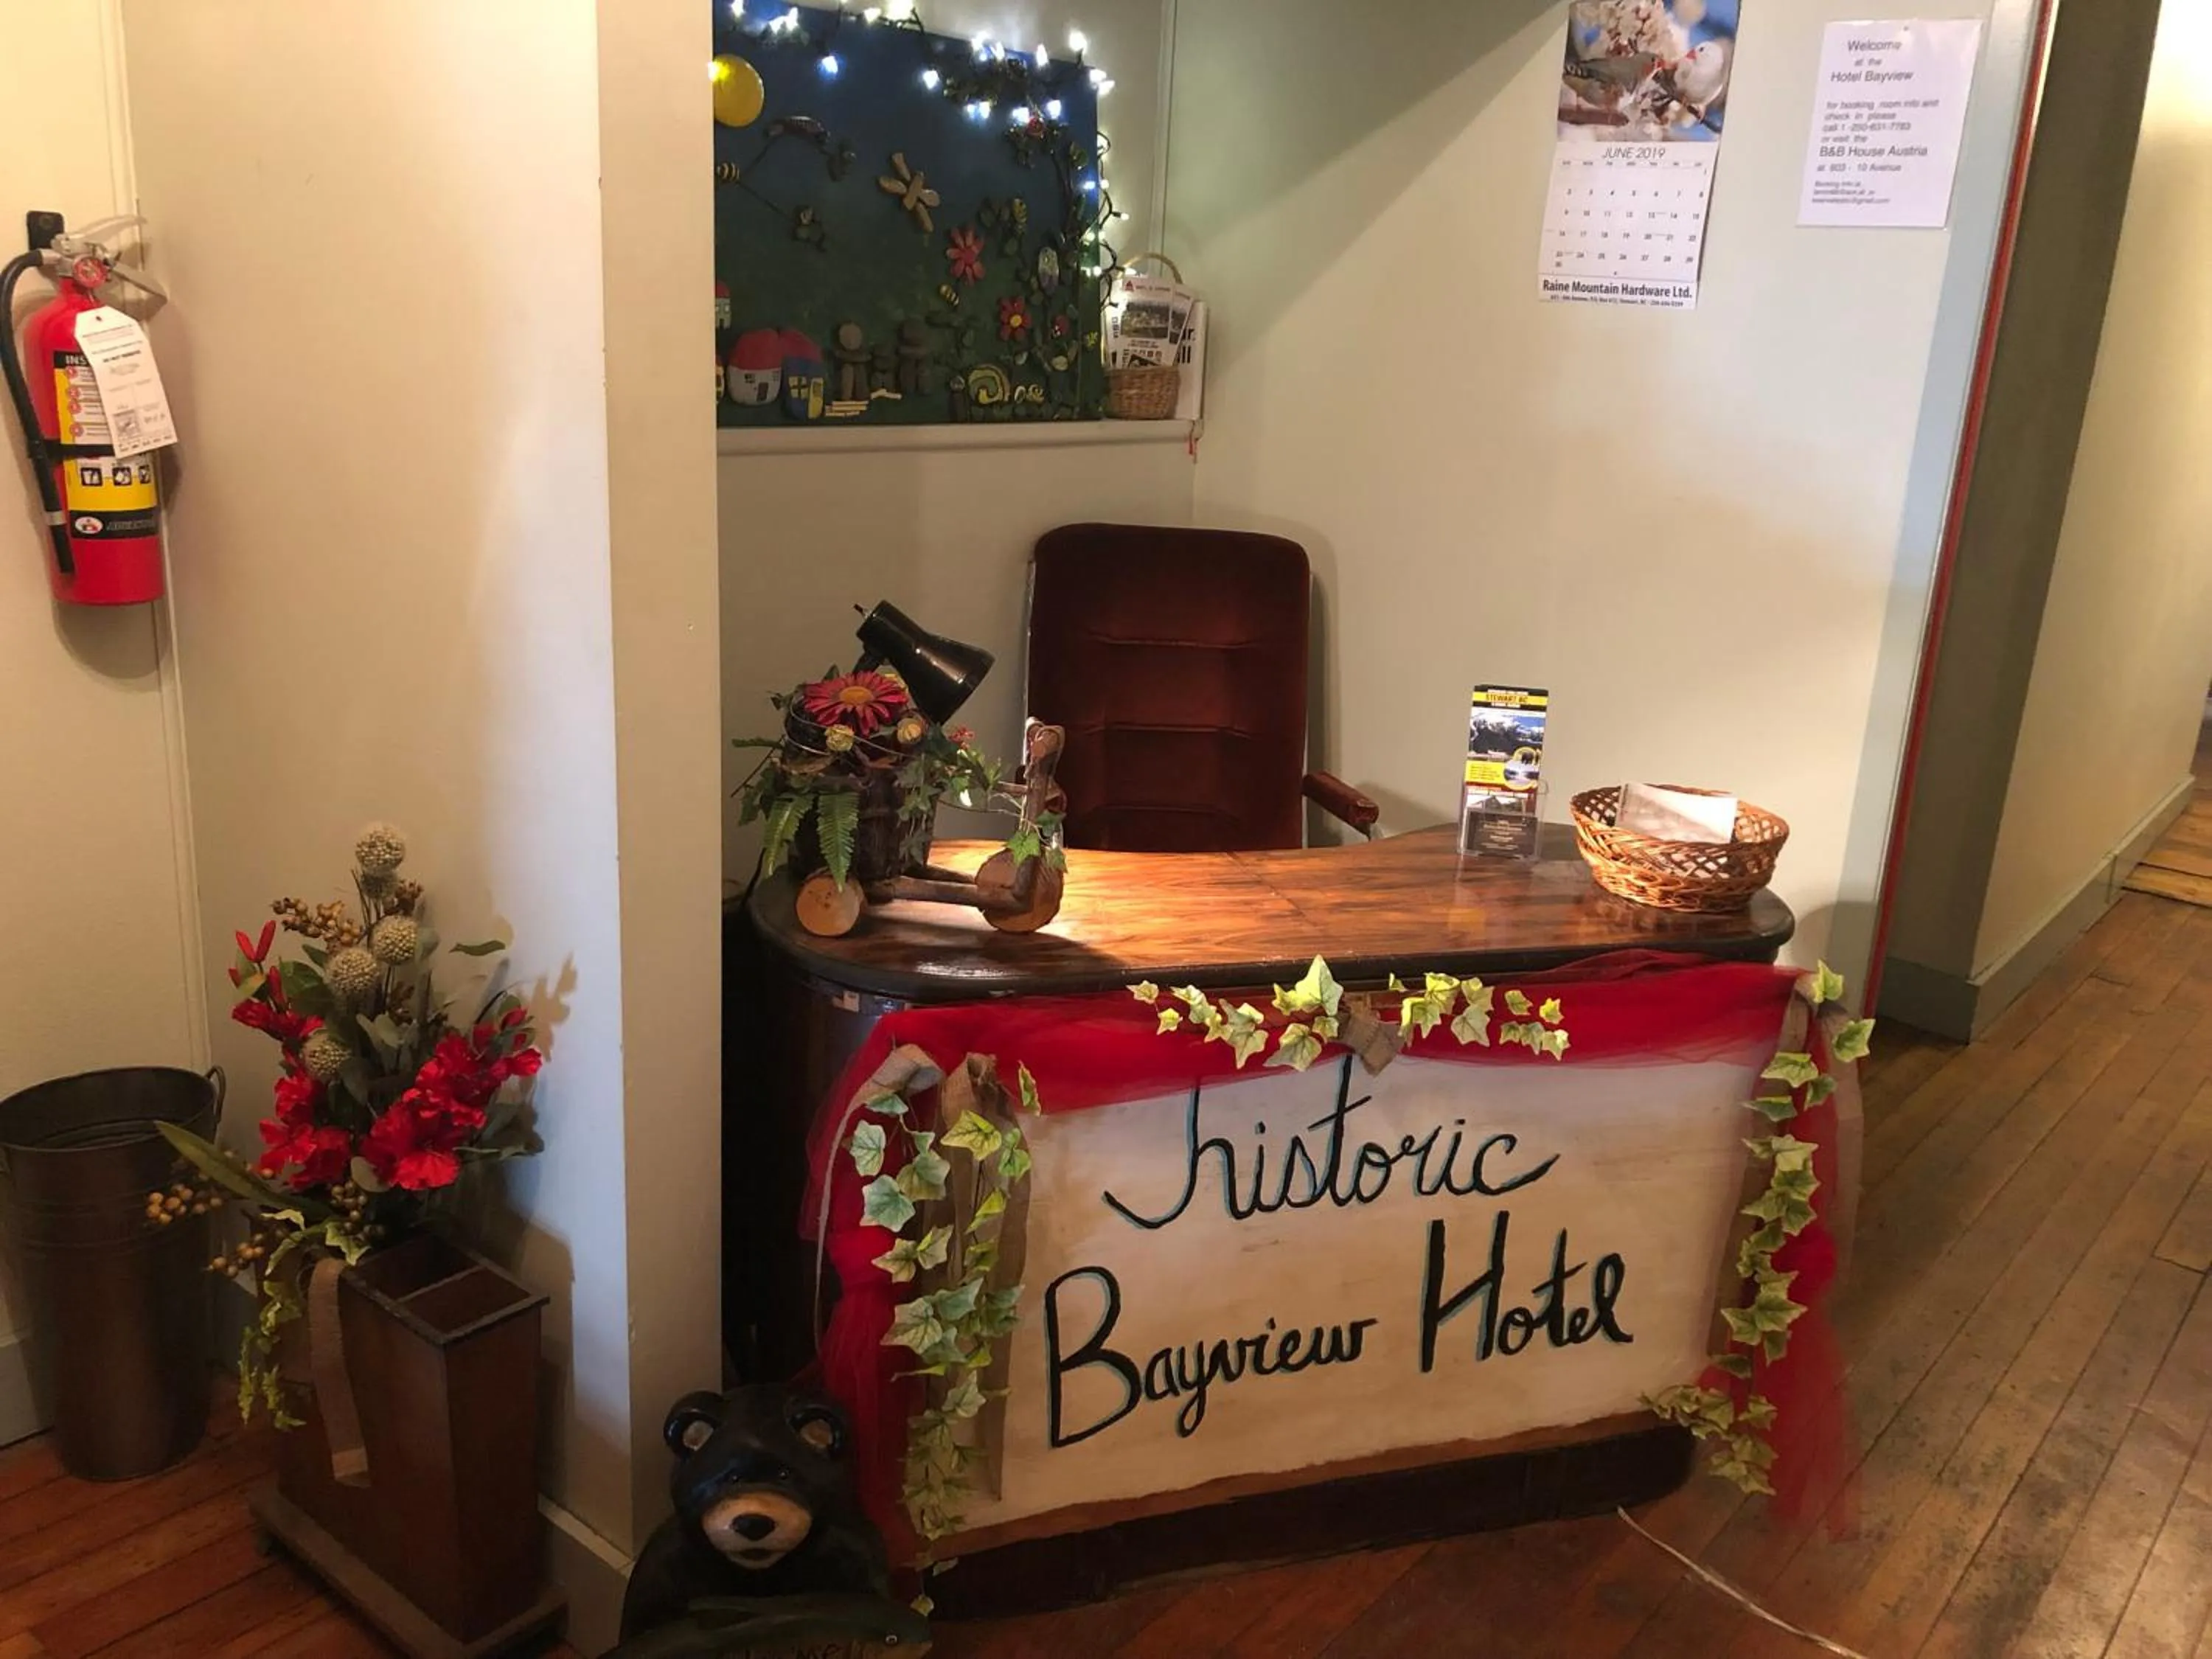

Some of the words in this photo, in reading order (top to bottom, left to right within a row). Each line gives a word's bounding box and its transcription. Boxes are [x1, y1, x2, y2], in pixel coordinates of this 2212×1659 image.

[1848, 40, 1902, 52] Welcome
[1830, 71, 1863, 82] Hotel
[1865, 71, 1914, 83] Bayview
[1602, 147, 1635, 159] JUNE
[1635, 147, 1666, 159] 2019
[1819, 146, 1845, 156] B&B
[1848, 146, 1885, 156] House
[1888, 145, 1927, 156] Austria
[1543, 279, 1570, 292] Raine
[1572, 280, 1619, 294] Mountain
[1621, 283, 1671, 296] Hardware
[1673, 285, 1692, 298] Ltd.
[1102, 1054, 1560, 1230] historic
[1045, 1265, 1377, 1448] Bayview
[1419, 1210, 1633, 1374] Hotel
